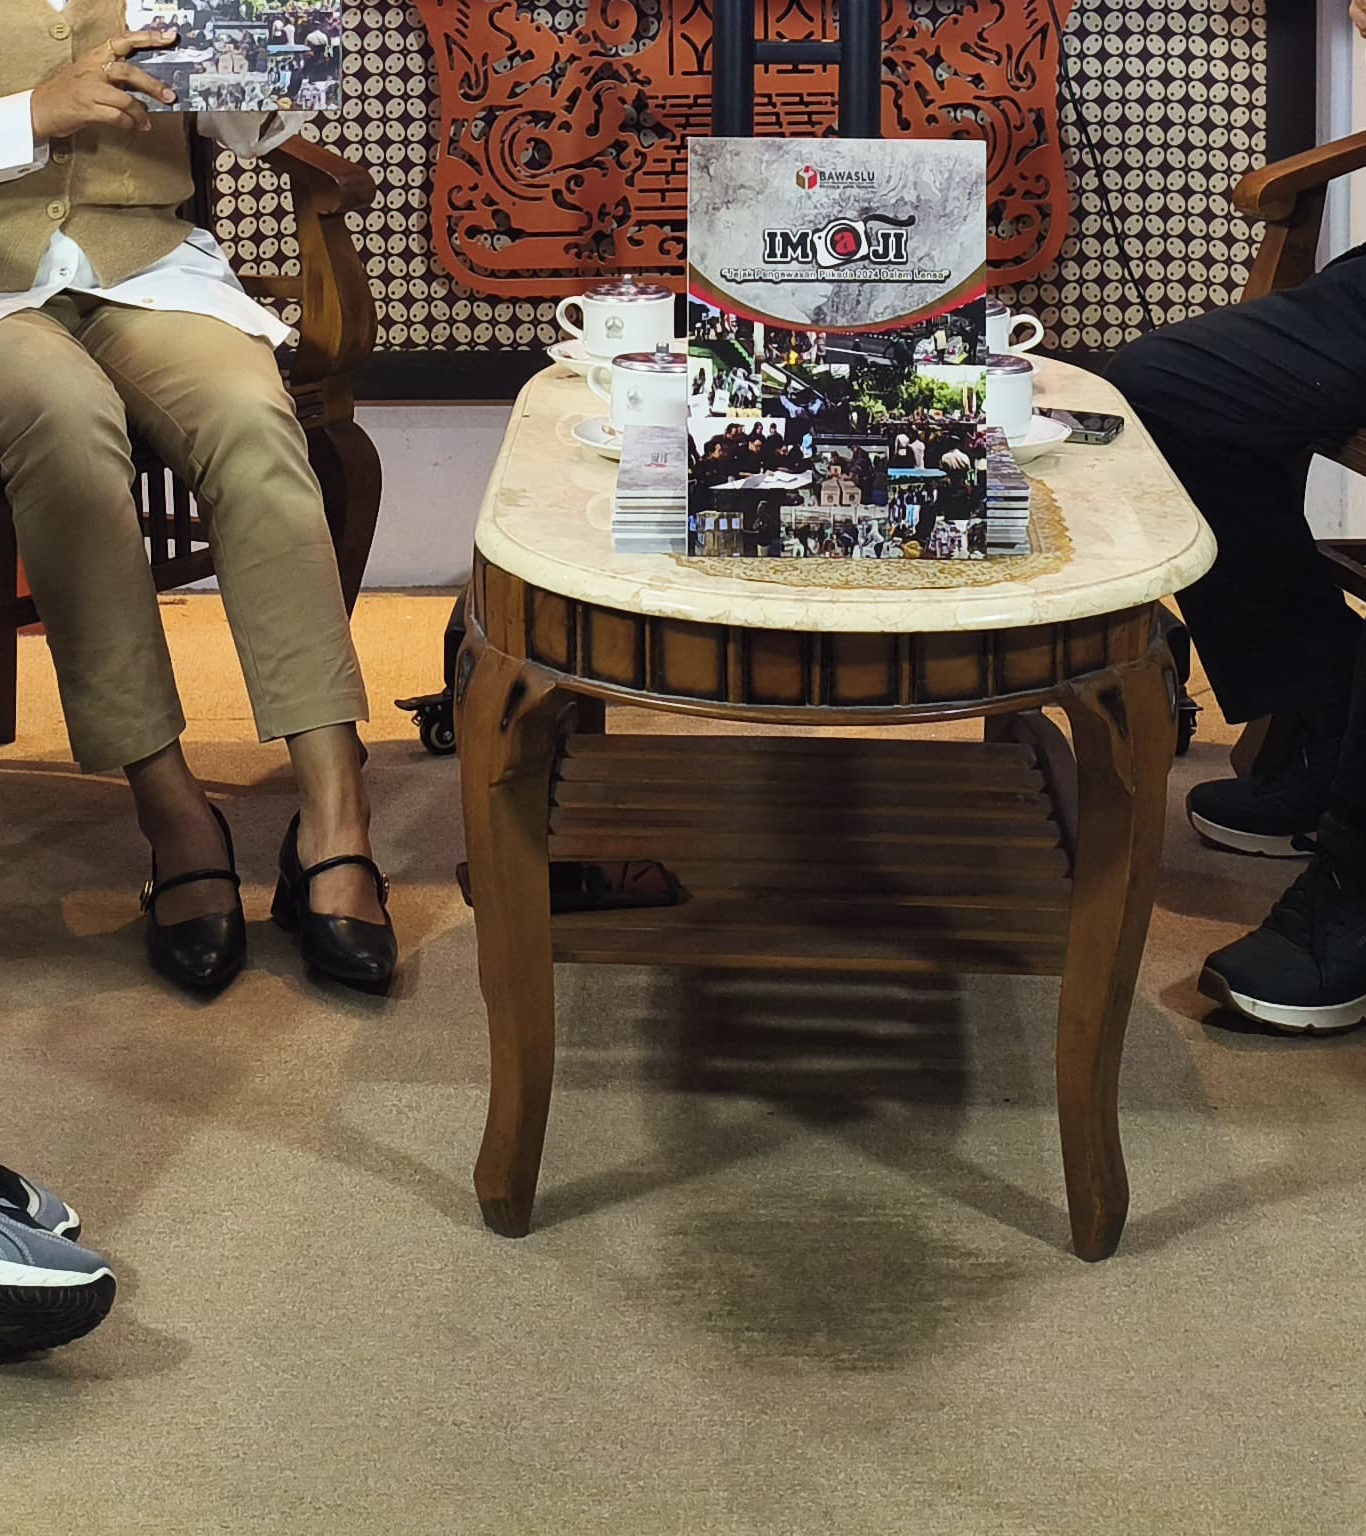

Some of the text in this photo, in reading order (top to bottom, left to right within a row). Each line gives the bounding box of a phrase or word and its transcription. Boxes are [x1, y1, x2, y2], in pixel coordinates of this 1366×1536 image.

[819, 171, 875, 182] BAWASLU
[856, 269, 879, 280] 2024
[882, 269, 912, 280] Dalam
